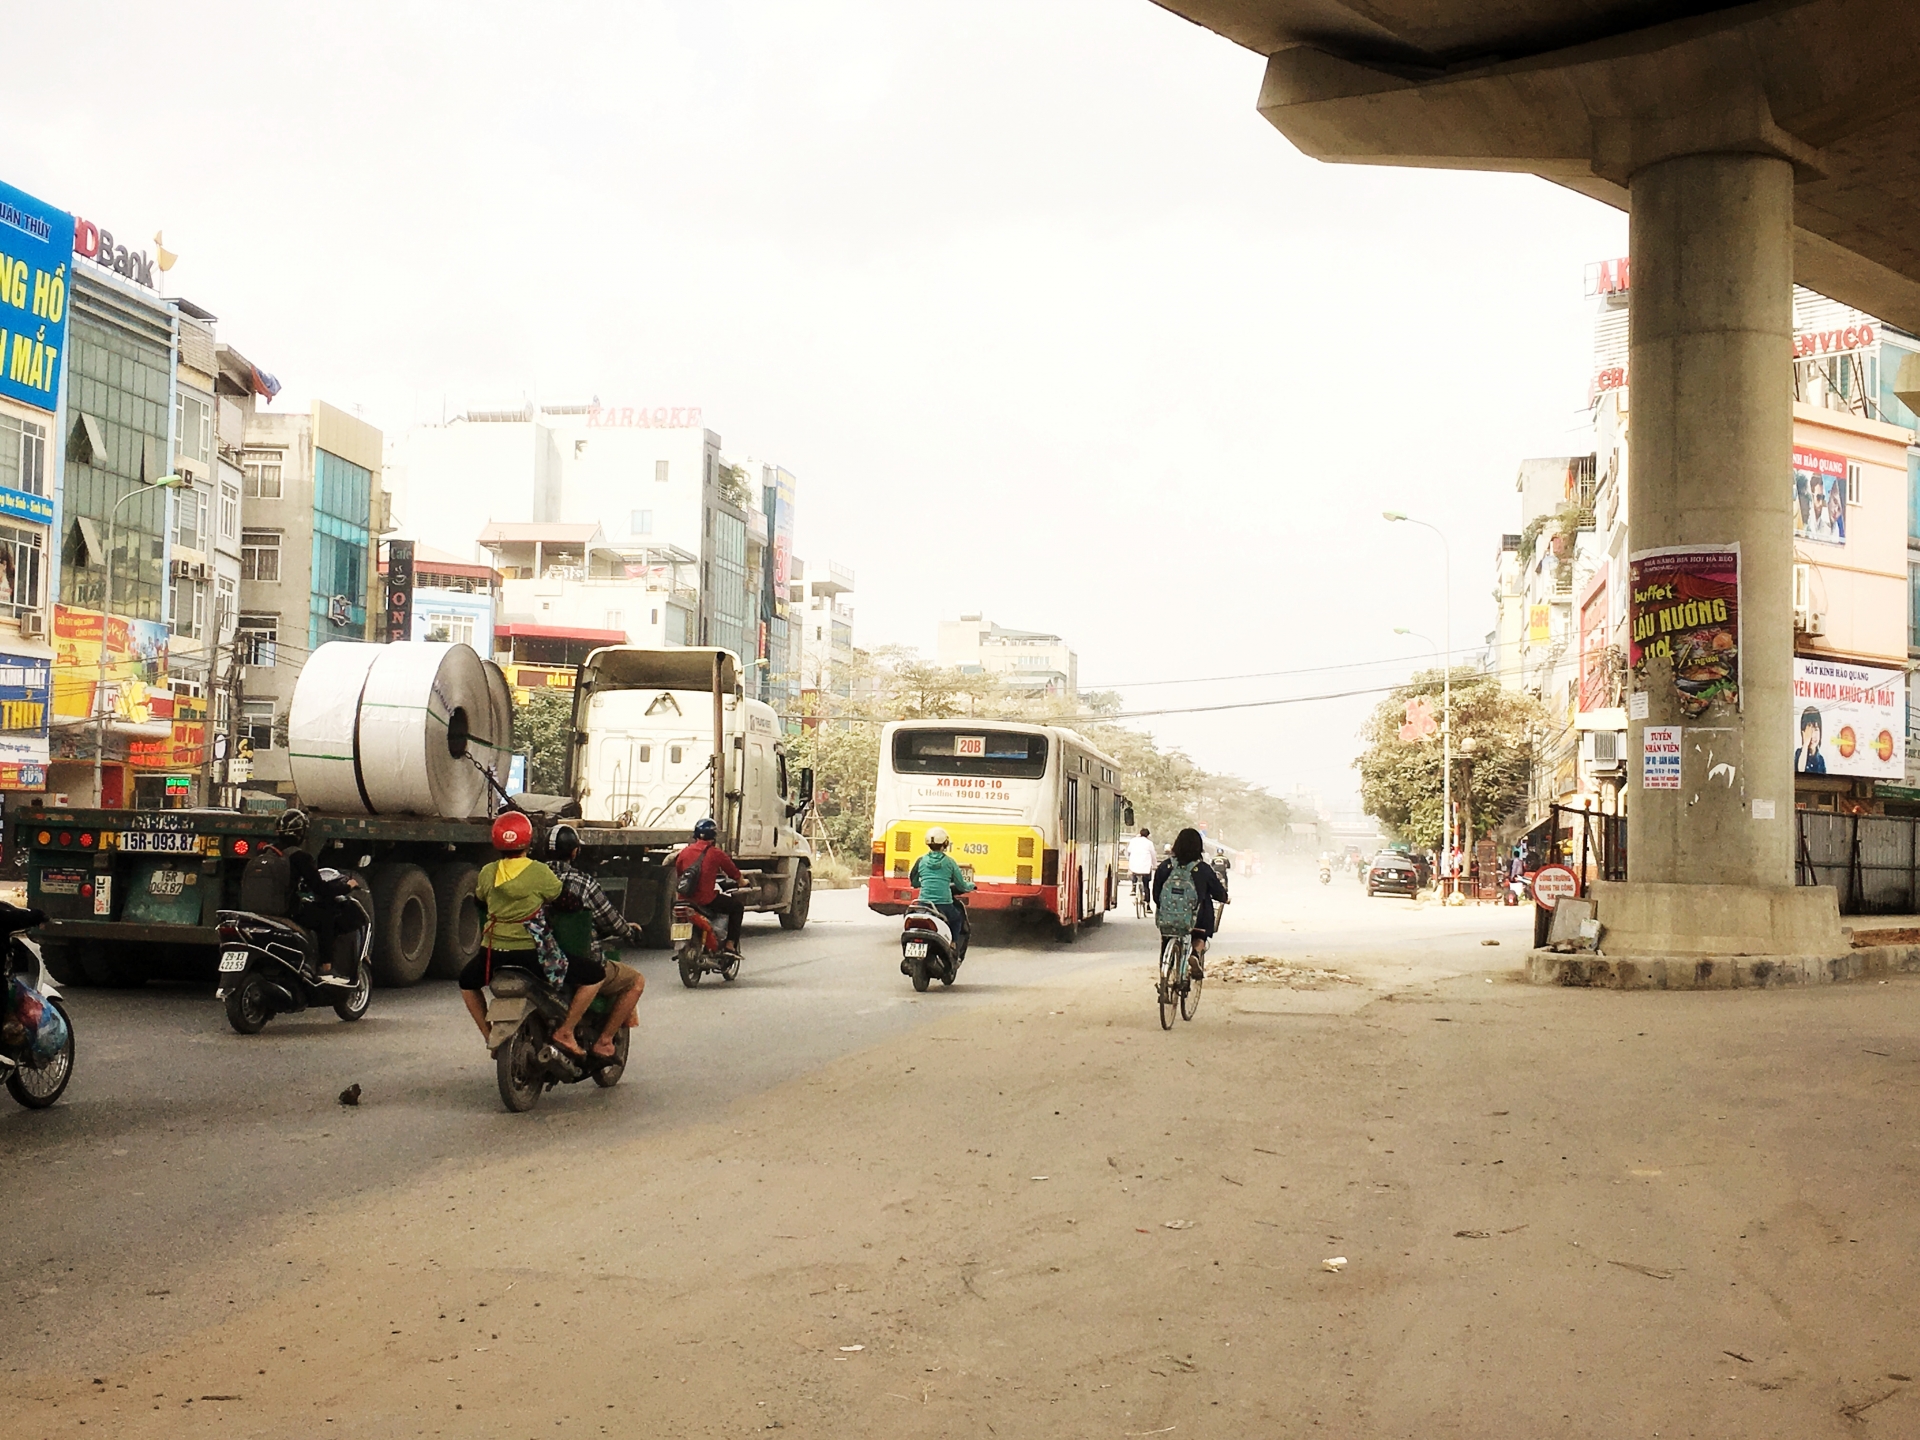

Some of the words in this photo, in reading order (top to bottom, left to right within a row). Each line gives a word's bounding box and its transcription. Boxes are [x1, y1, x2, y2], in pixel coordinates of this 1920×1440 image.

[32, 262, 65, 324] HỒ
[9, 324, 57, 393] MẮT
[586, 405, 702, 428] KARAOKE
[1819, 458, 1843, 474] QUANG
[1634, 583, 1673, 604] buffet
[1659, 598, 1728, 633] NƯỚNG
[1819, 665, 1835, 677] KÍNH
[1848, 670, 1869, 681] QUANG
[1813, 681, 1837, 700] KHOA
[1839, 682, 1862, 703] KHÚC
[1864, 687, 1875, 708] XẠ
[1877, 686, 1895, 707] MẮT
[1, 689, 45, 732] THỦY
[1650, 728, 1672, 741] TUYỂN
[960, 739, 981, 753] 20B
[1663, 742, 1680, 753] VIÊN
[952, 779, 973, 787] BUS
[925, 789, 953, 798] Hotline
[123, 832, 195, 851] 15R-093.87
[963, 843, 989, 855] 4393
[161, 871, 178, 882] 15R
